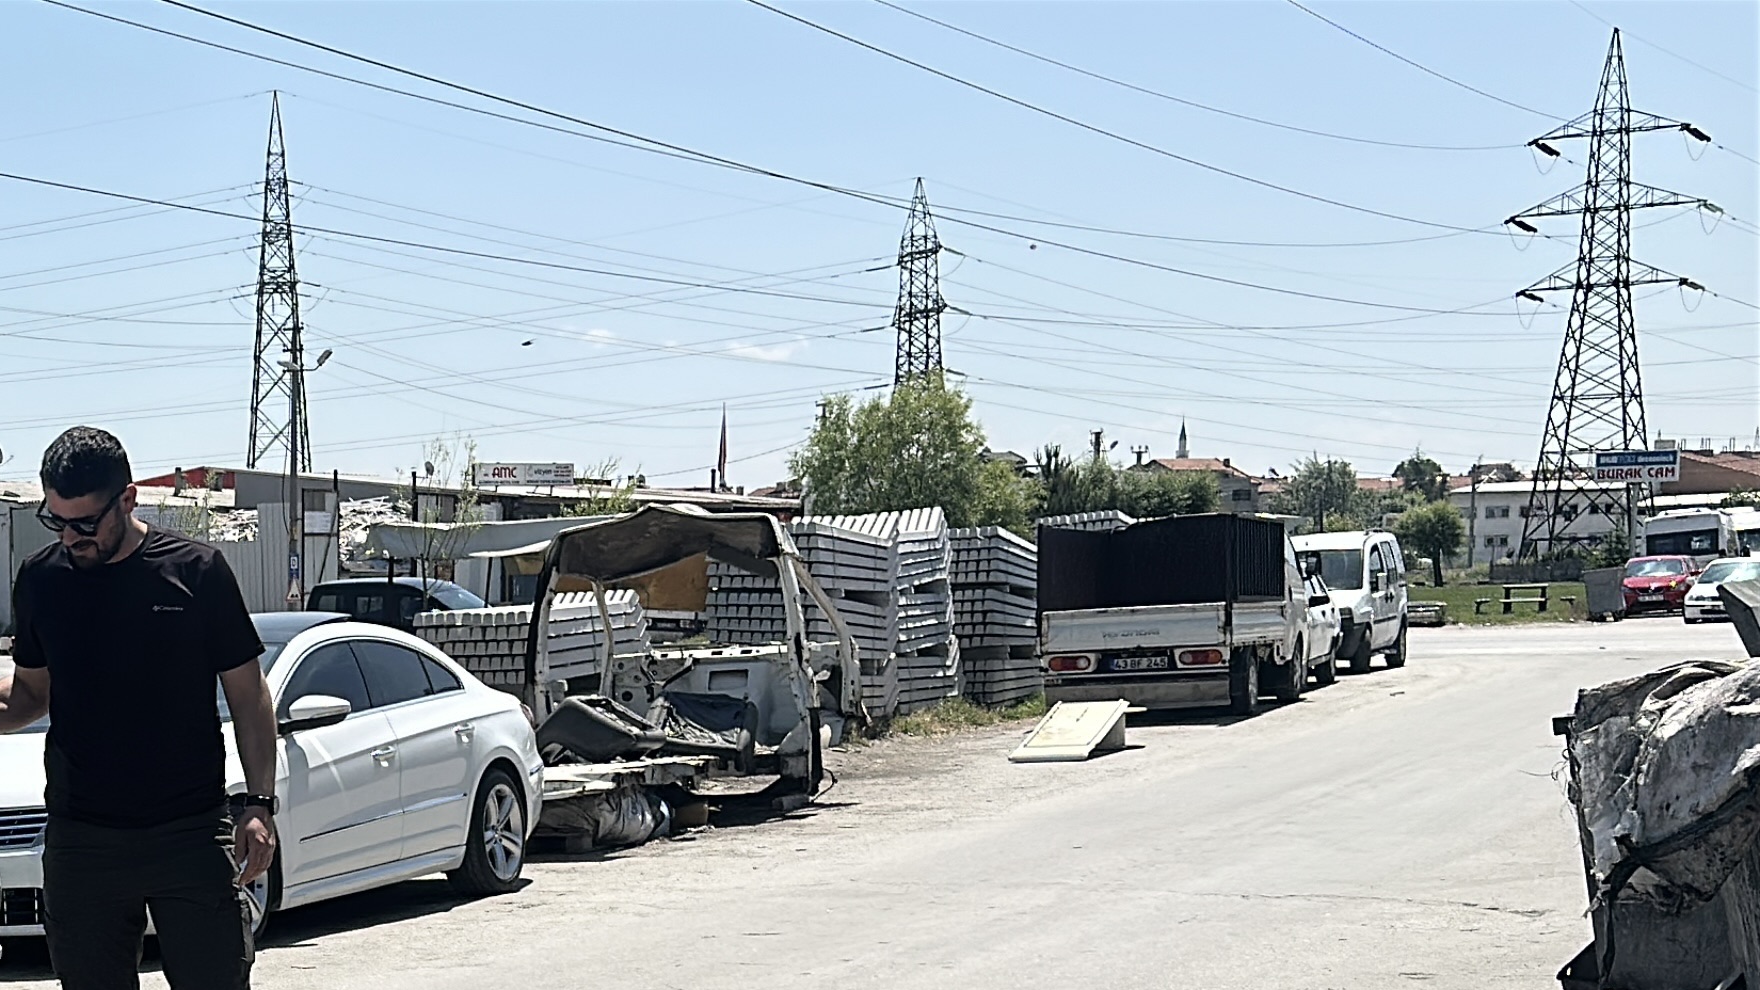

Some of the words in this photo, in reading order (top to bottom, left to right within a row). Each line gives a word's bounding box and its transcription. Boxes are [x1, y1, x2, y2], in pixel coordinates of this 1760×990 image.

[492, 467, 517, 478] AMC
[1597, 467, 1642, 479] BURAK
[1647, 467, 1675, 478] CAM
[1146, 658, 1167, 668] 245
